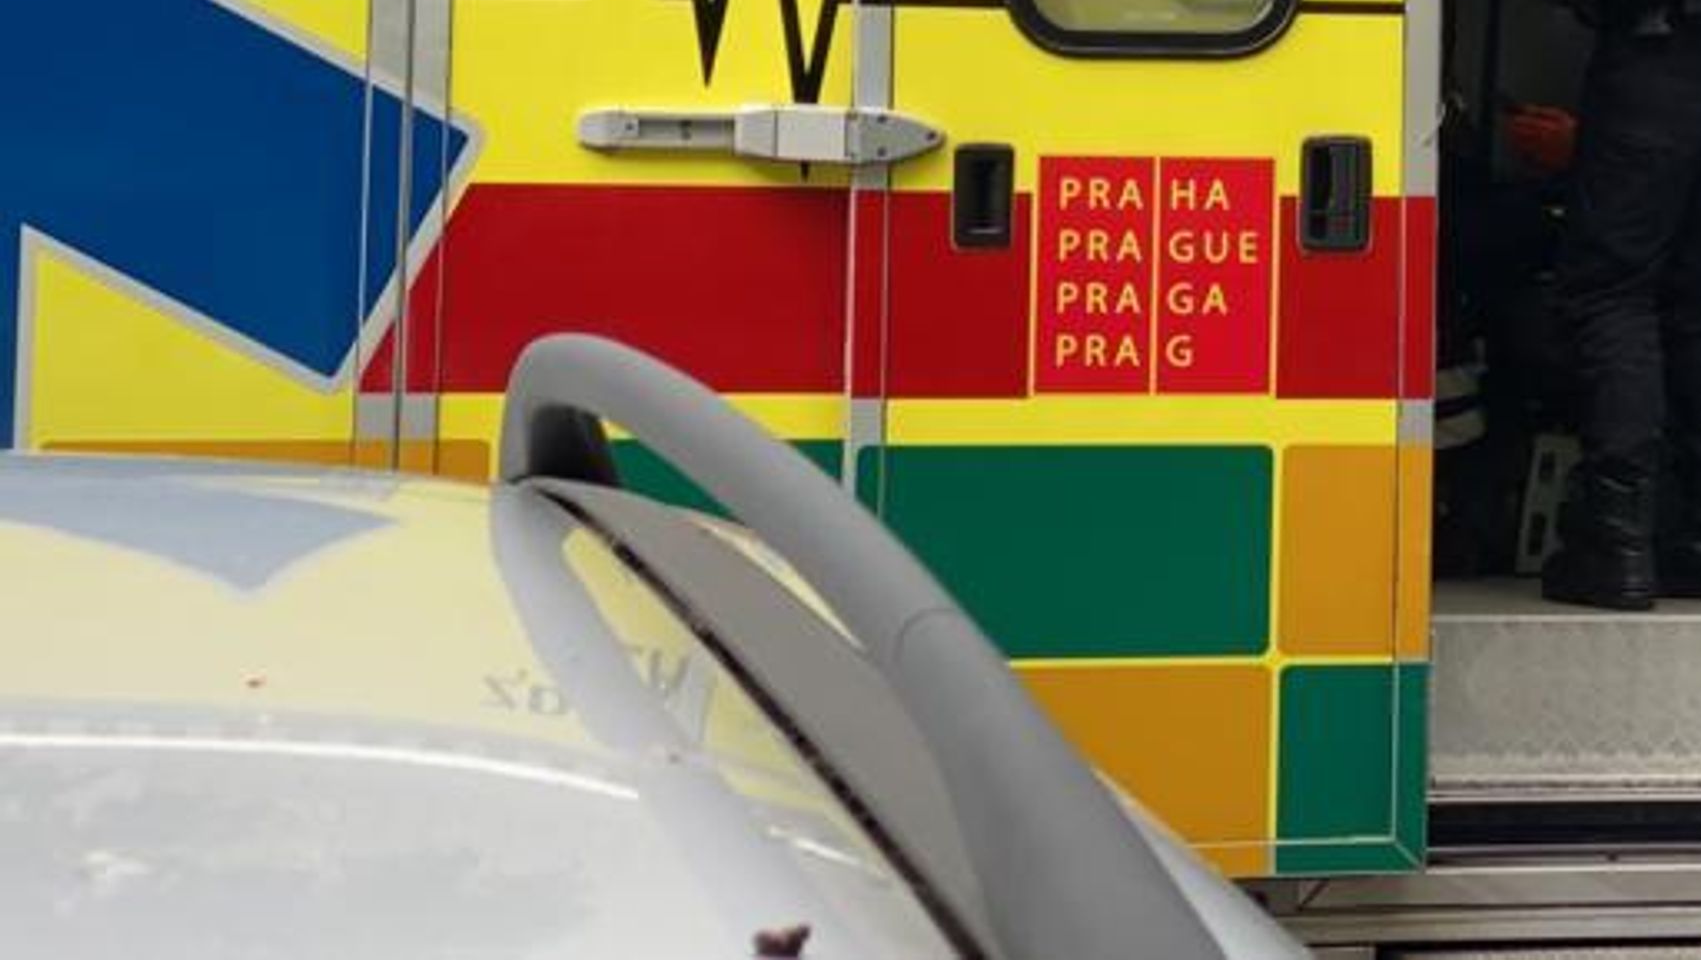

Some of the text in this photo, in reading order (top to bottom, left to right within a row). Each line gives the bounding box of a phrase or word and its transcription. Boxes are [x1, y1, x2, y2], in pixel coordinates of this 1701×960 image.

[1058, 176, 1231, 212] PRA HA
[1058, 228, 1260, 264] PRA GUE
[1056, 281, 1229, 316] PRA GA
[1055, 333, 1194, 368] PRA G
